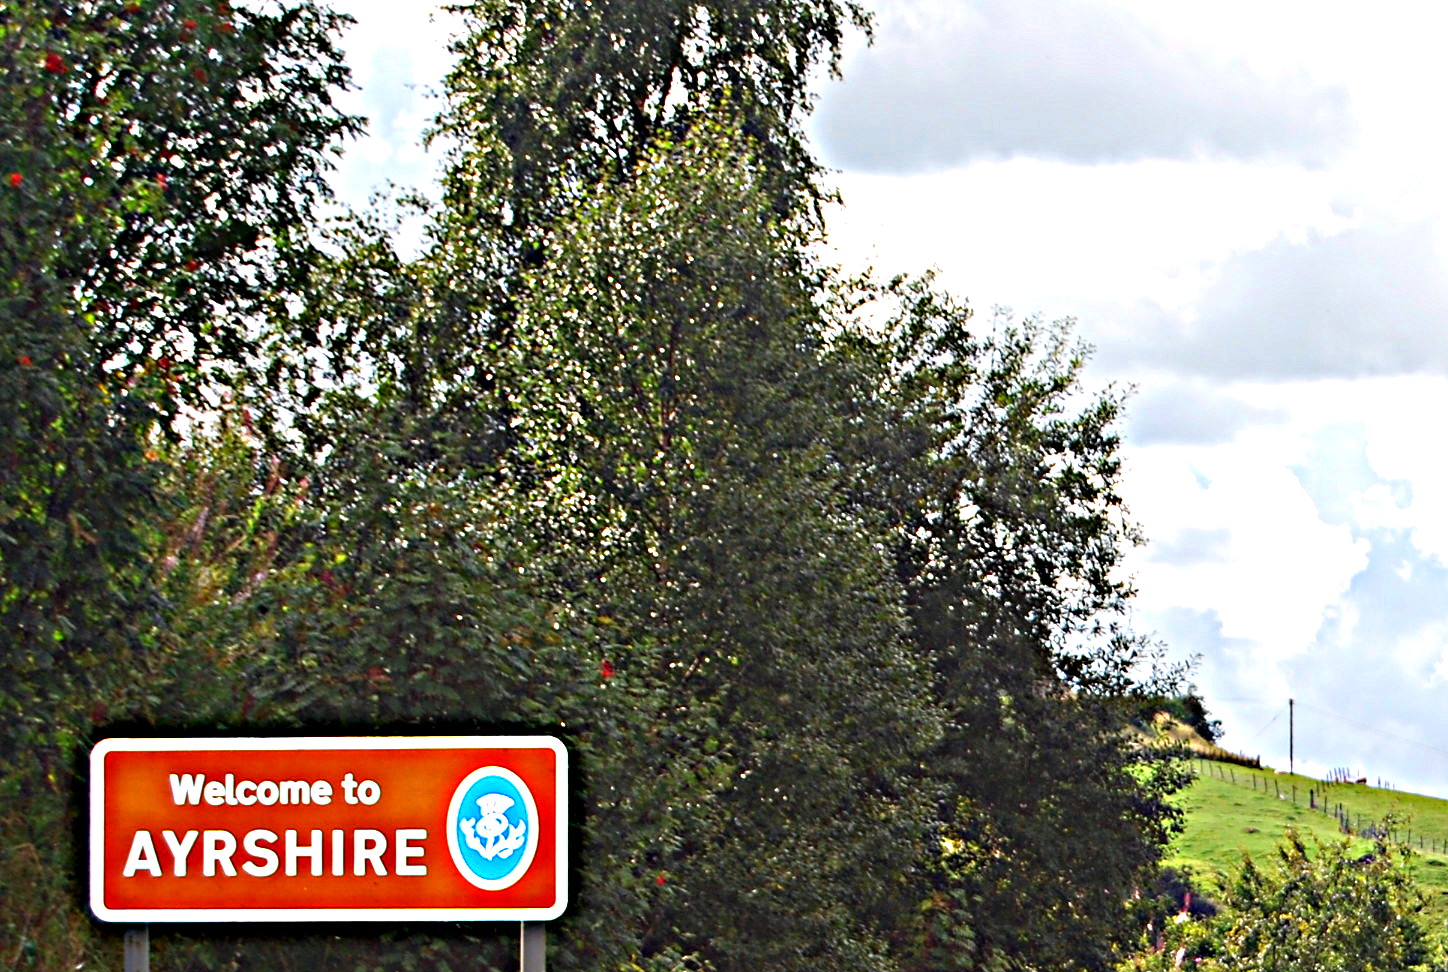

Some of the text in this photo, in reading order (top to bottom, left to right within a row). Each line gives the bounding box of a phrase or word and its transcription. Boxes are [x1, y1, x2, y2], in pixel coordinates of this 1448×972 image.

[168, 772, 382, 806] Welcome to
[122, 829, 428, 878] AYRSHIRE
